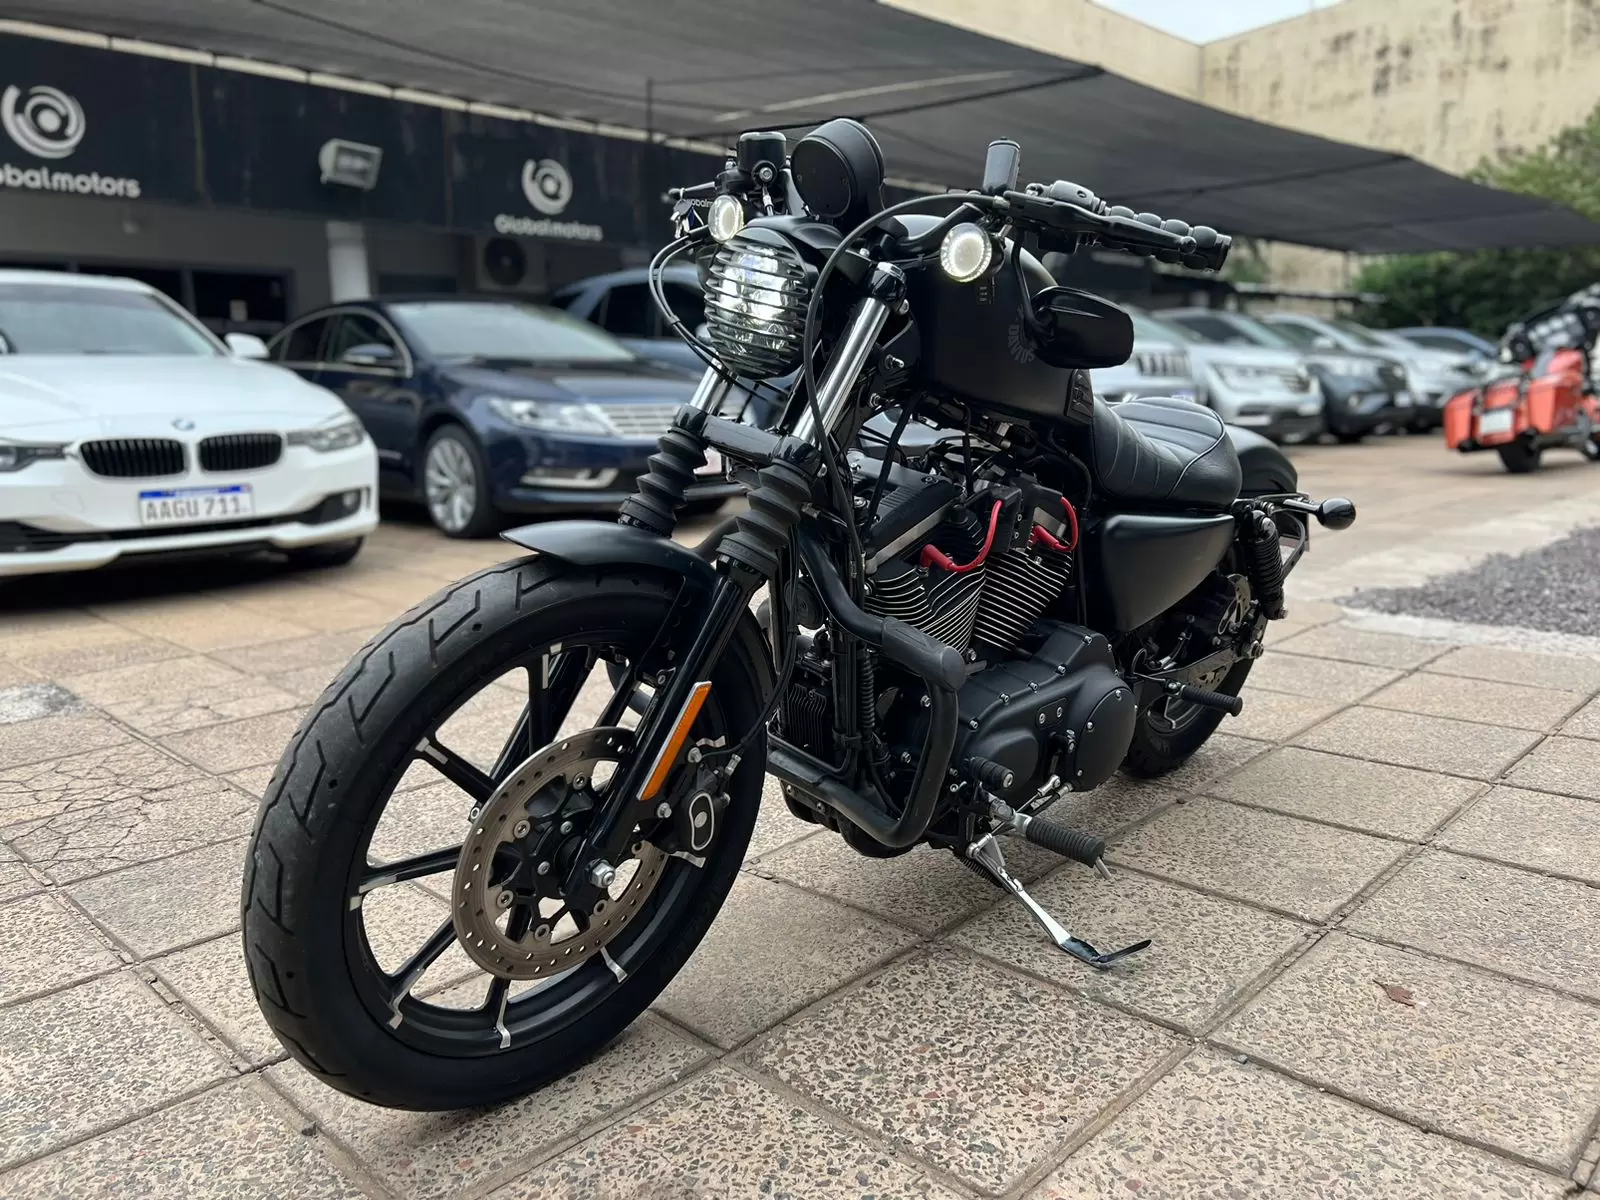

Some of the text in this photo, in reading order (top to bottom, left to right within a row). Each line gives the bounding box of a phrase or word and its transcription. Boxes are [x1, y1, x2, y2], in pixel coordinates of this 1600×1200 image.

[0, 163, 141, 198] balmotors
[146, 496, 240, 520] AAGU 711
